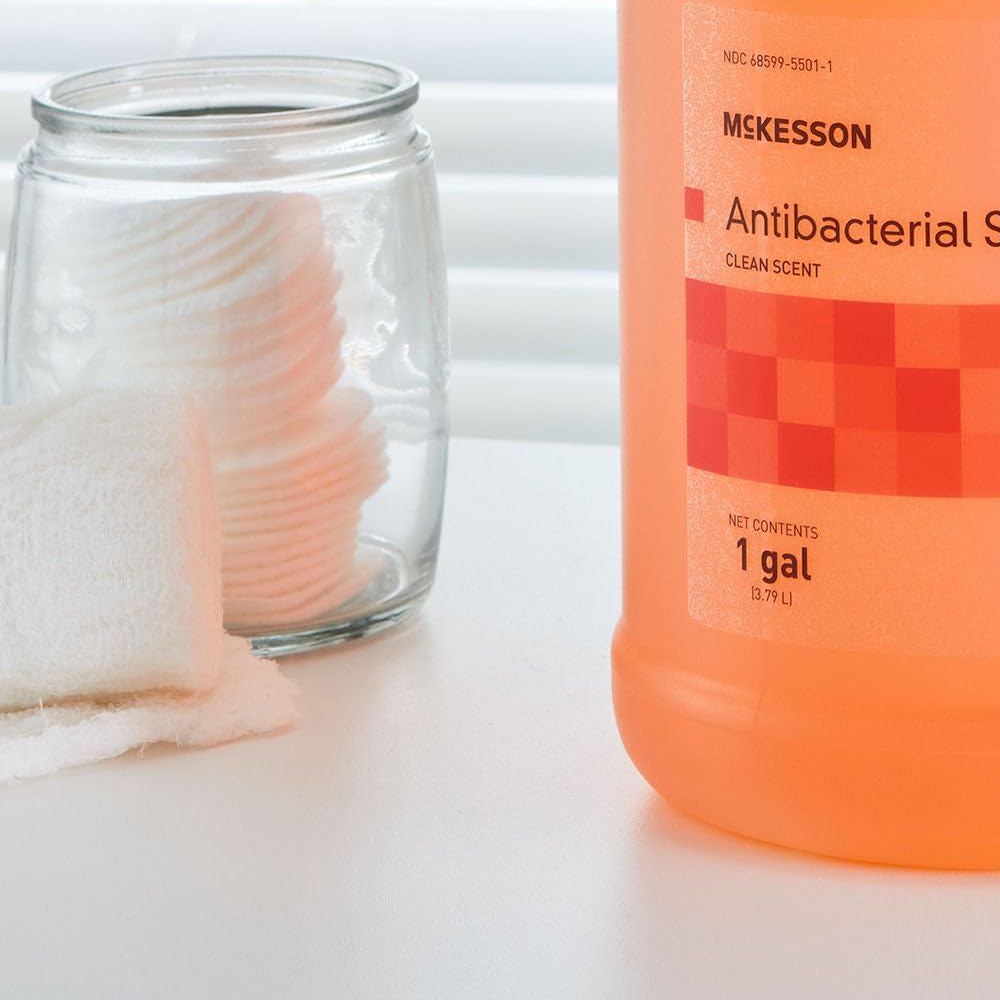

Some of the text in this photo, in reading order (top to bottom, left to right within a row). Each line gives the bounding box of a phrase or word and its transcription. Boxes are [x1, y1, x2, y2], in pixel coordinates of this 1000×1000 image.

[723, 50, 833, 73] NDC 68599-5501-1
[726, 196, 972, 248] Antibacterial
[726, 252, 822, 278] CLEAN SCENT
[728, 513, 819, 540] NET CONTENTS
[736, 537, 812, 584] 1 gal
